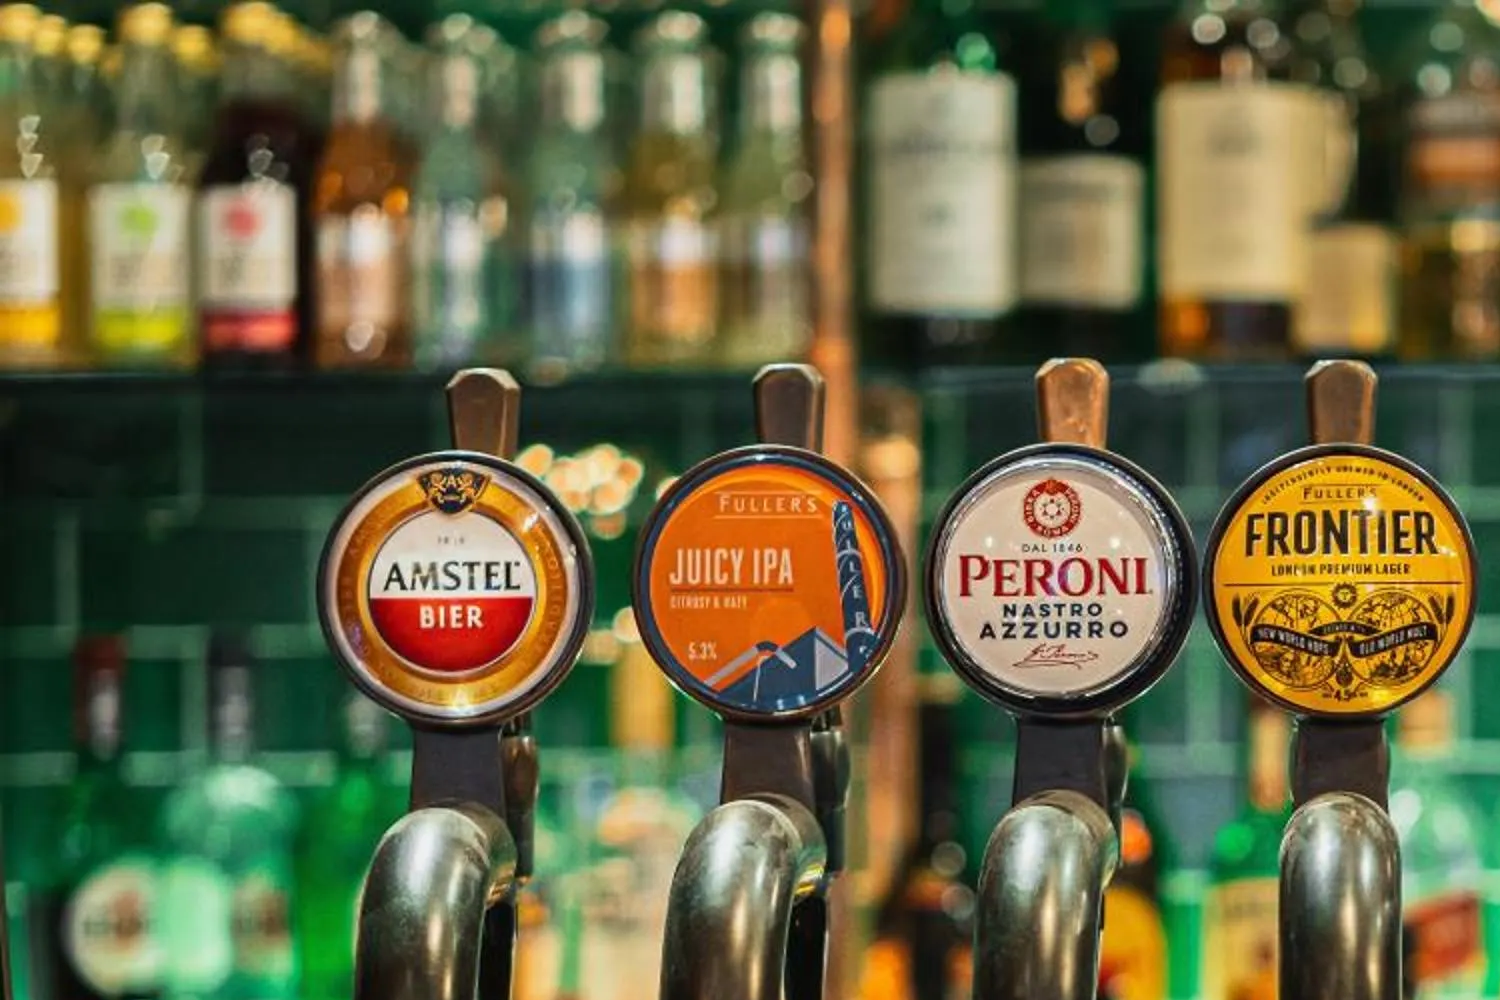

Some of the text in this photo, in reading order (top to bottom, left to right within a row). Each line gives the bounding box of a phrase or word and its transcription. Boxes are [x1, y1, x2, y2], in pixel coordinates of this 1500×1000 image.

[719, 494, 818, 513] FULLER'S
[1245, 508, 1440, 557] FRONTIER
[1022, 543, 1048, 553] DAL
[383, 561, 520, 592] AMSTEL
[669, 548, 794, 586] JUICY IPA
[958, 555, 1149, 598] PERONI
[1320, 562, 1373, 575] PREMIUM
[1375, 562, 1411, 575] LAGER
[420, 604, 484, 630] BIER
[1003, 603, 1103, 618] NASTRO
[979, 620, 1129, 640] AZZURRO
